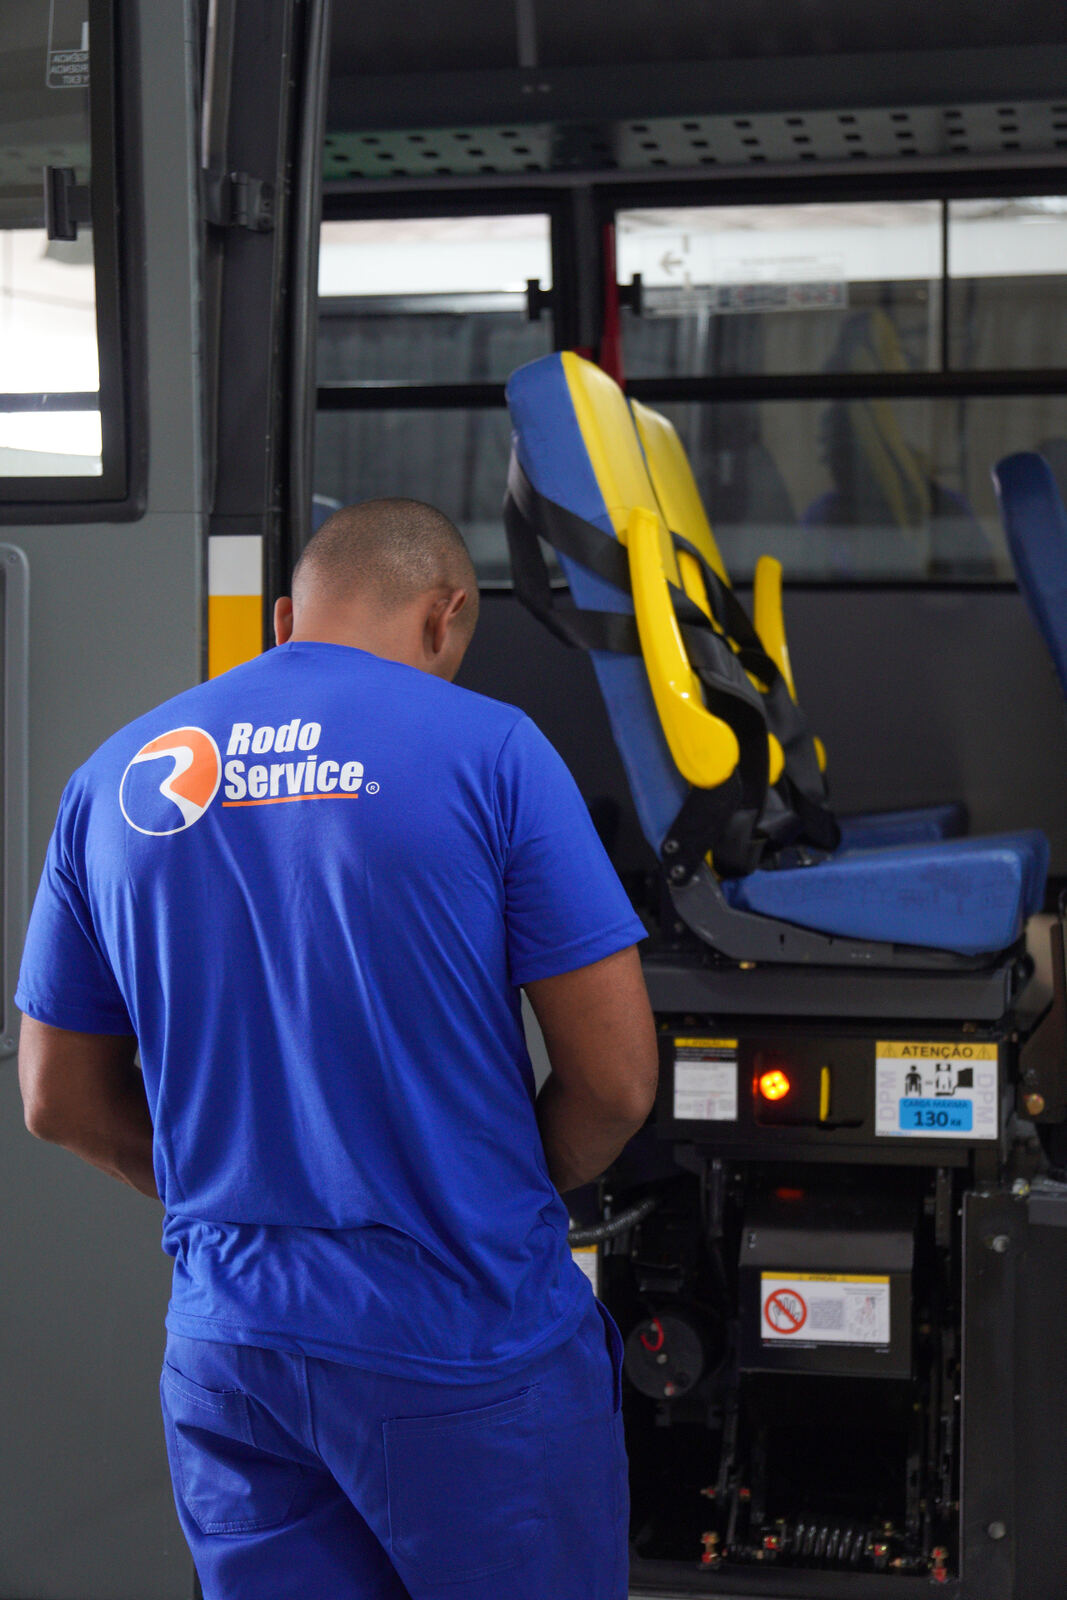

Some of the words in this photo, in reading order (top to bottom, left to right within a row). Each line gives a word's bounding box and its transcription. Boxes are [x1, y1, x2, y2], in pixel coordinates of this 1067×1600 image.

[226, 719, 322, 756] Rodo
[224, 755, 365, 800] Service
[901, 1044, 974, 1059] ATENÇÃO
[914, 1111, 949, 1128] 130
